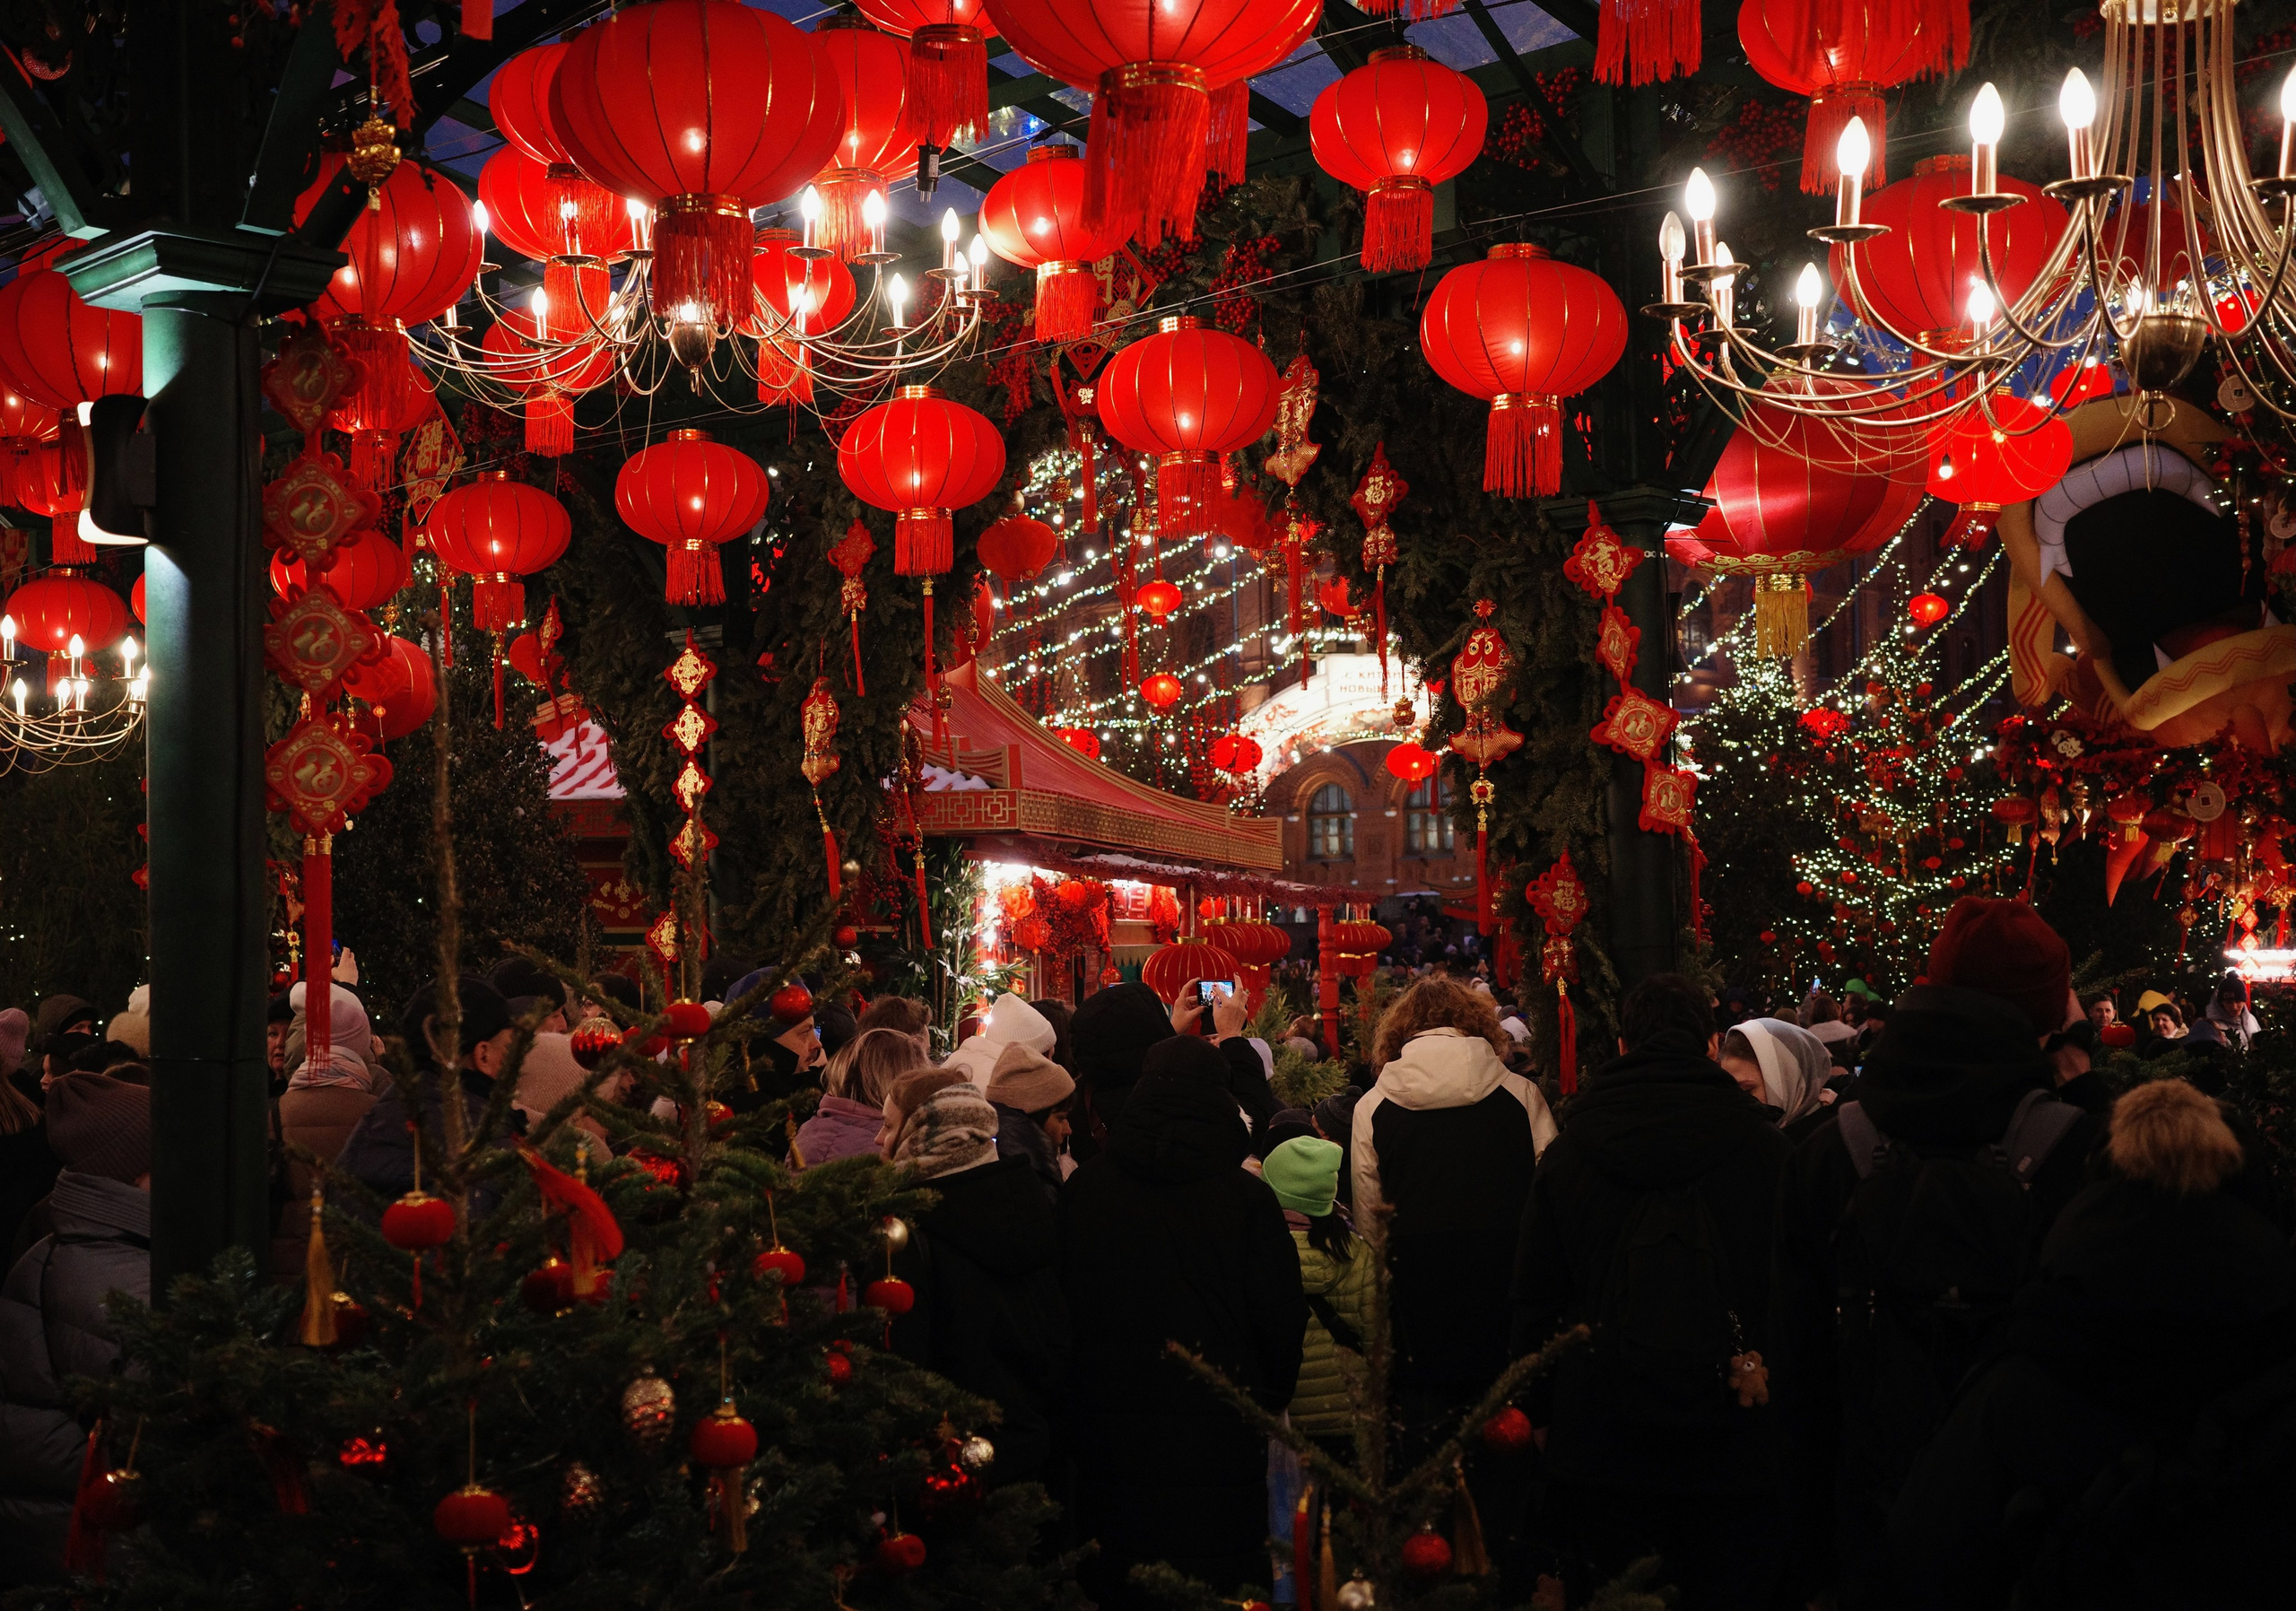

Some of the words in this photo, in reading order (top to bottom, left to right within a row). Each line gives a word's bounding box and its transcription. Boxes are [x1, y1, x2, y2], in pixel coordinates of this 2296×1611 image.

[1365, 475, 1386, 504] 福
[290, 491, 334, 533] 福
[292, 619, 339, 662] 福
[1462, 676, 1478, 701] 福
[1624, 710, 1654, 738] 福
[294, 750, 342, 795] 福
[1659, 783, 1682, 812] 福
[1552, 879, 1578, 911] 福
